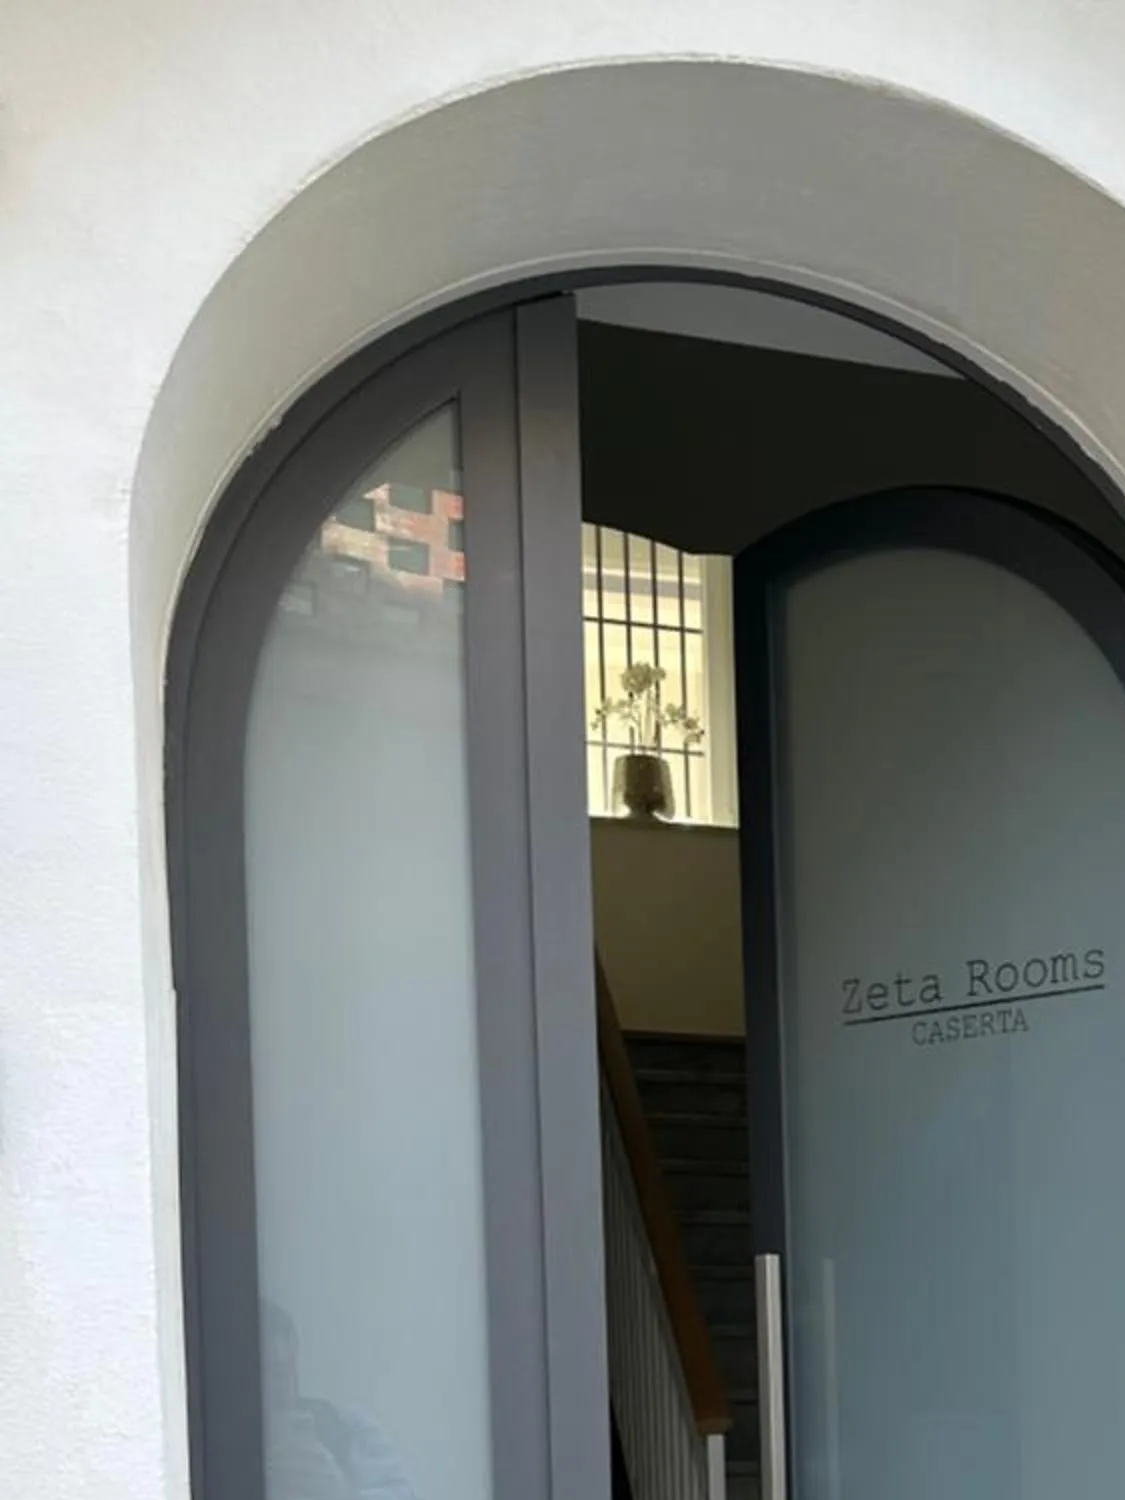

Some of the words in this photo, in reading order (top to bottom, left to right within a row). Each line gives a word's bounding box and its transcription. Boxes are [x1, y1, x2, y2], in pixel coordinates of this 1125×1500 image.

[841, 972, 943, 1015] Zeta
[966, 949, 1105, 997] Rooms
[911, 1007, 1030, 1046] CASERTA
